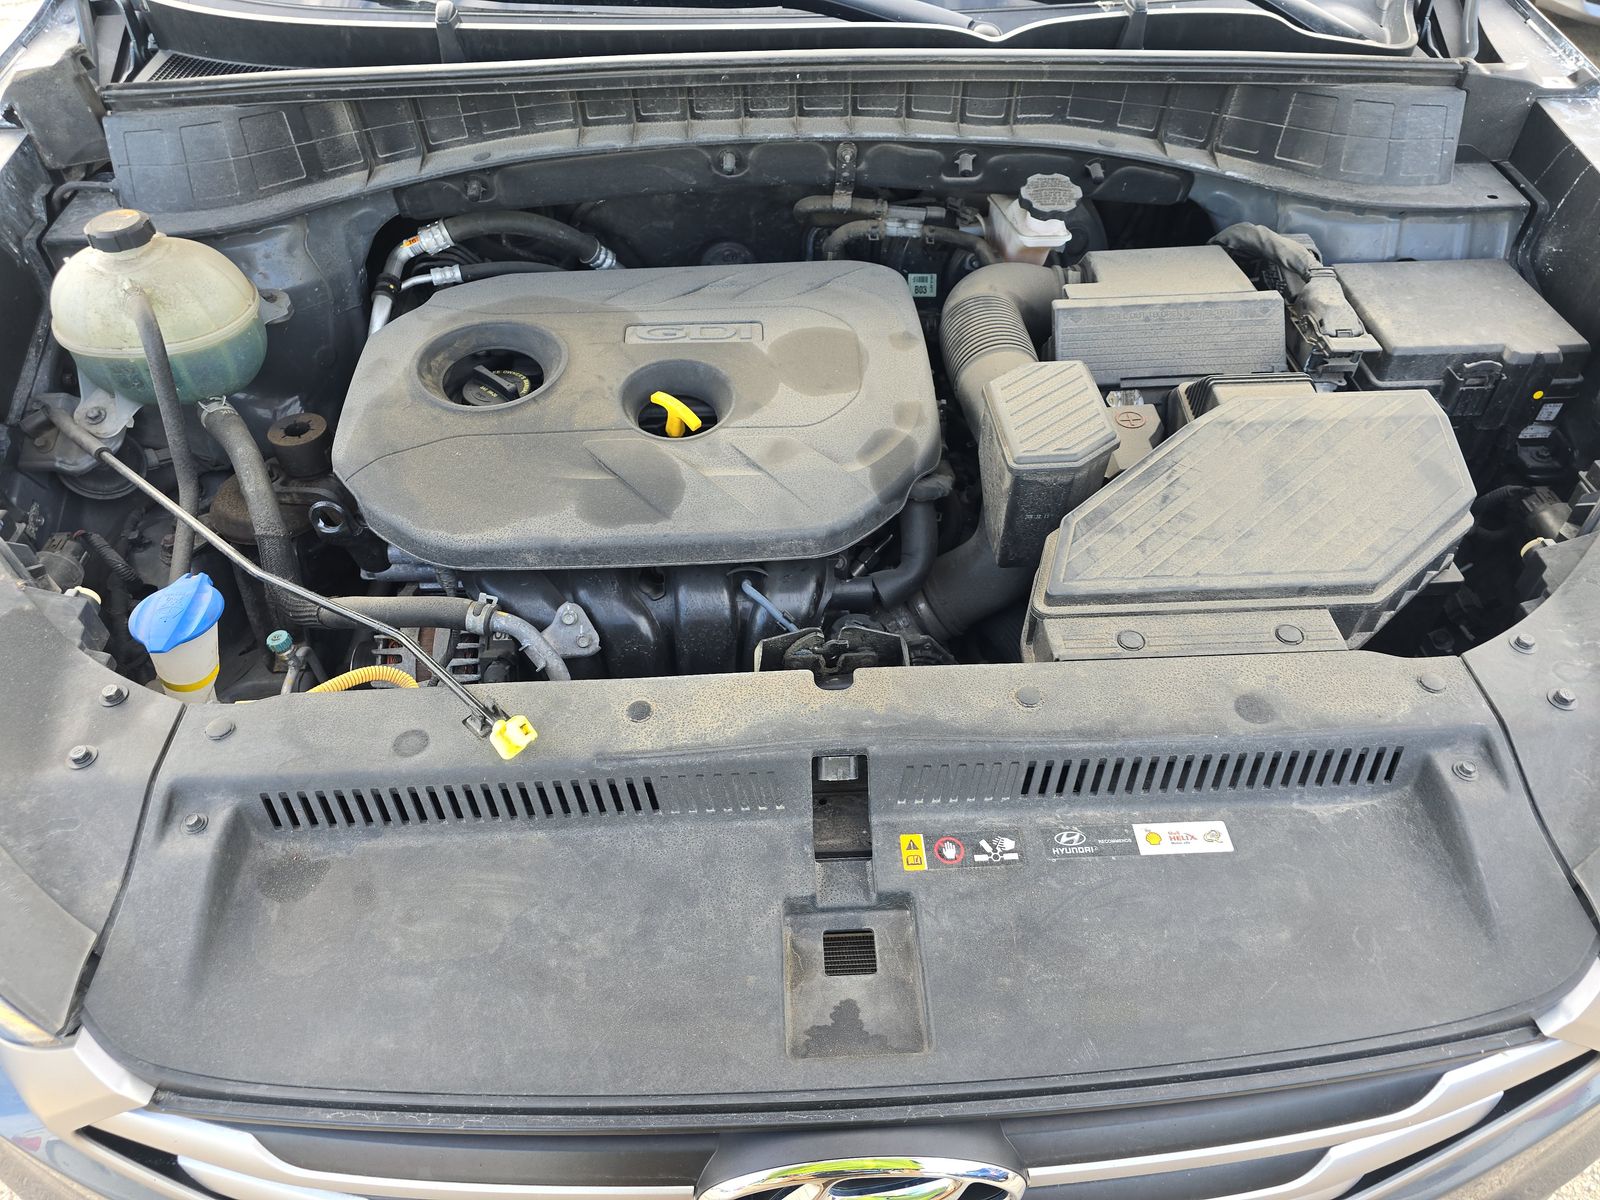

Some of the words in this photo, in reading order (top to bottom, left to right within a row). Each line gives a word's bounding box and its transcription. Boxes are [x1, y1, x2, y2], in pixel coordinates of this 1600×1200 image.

[636, 326, 753, 341] GDI
[1169, 833, 1198, 841] HELIX
[1052, 846, 1094, 855] HYUNDAI
